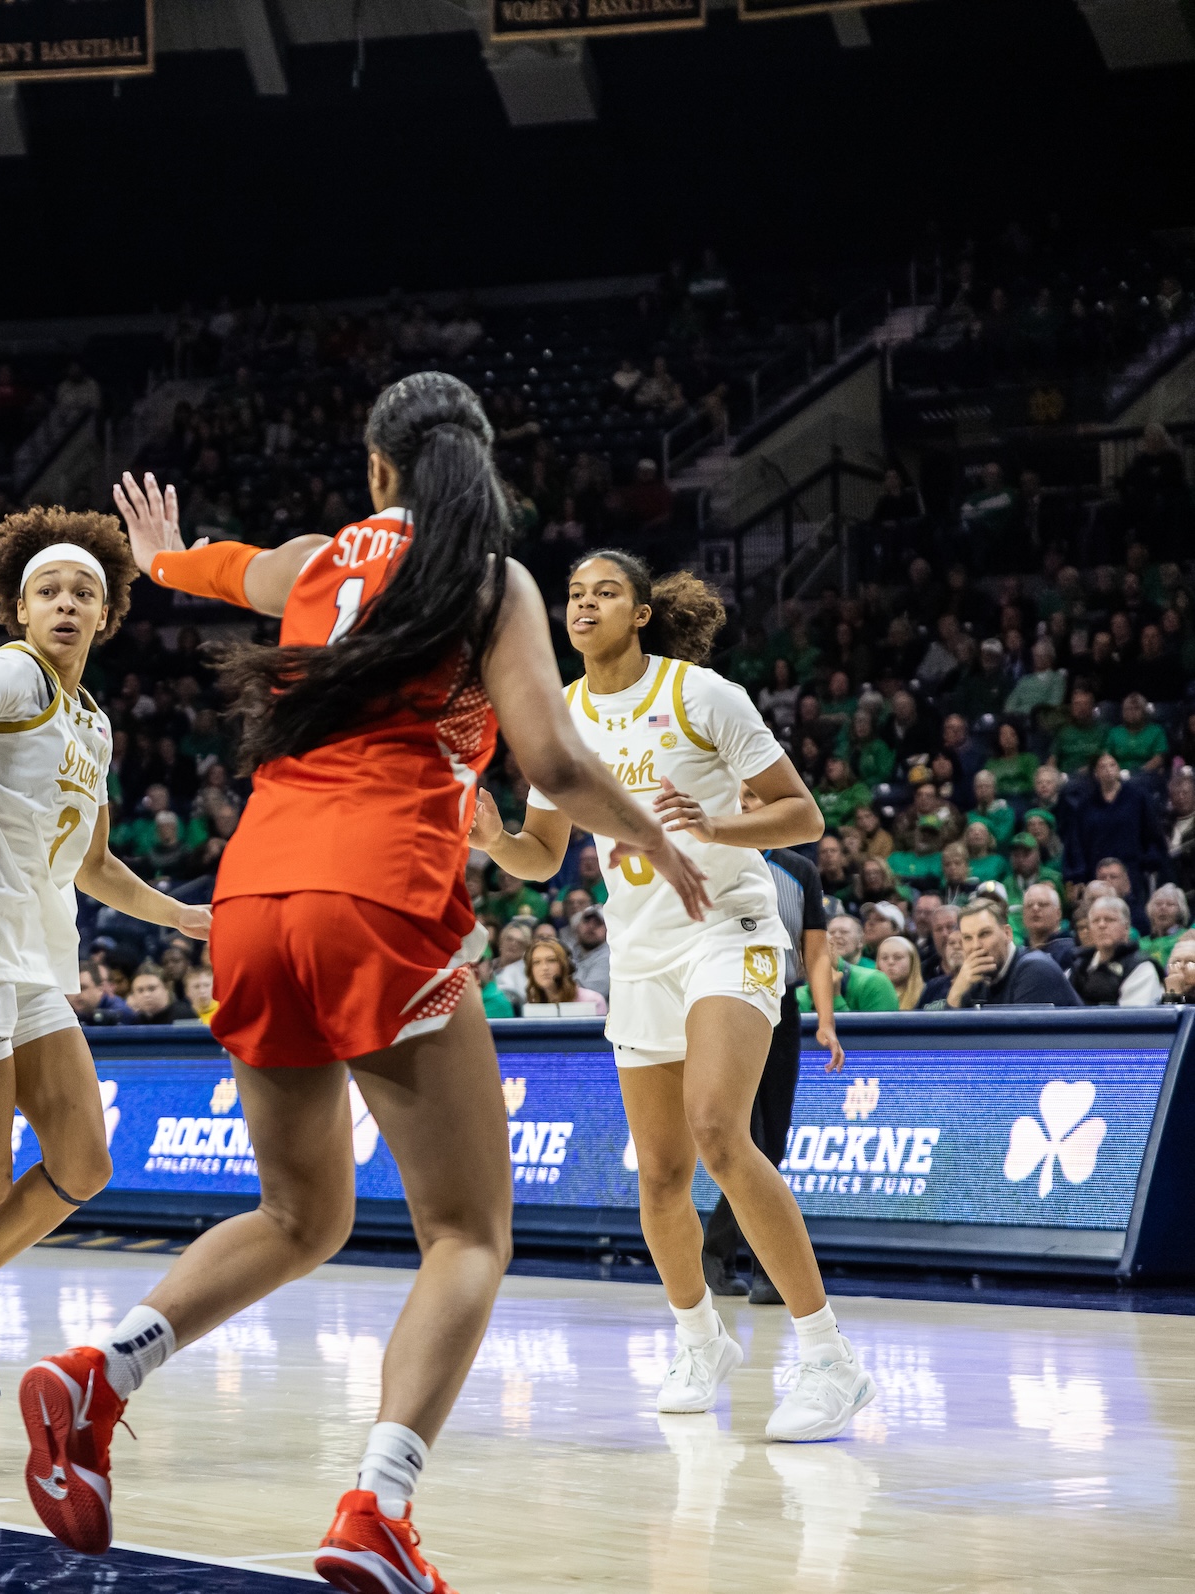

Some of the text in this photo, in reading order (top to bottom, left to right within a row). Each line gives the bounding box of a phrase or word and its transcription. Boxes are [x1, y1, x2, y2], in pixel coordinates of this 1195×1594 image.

[39, 36, 142, 62] BASKETBALL
[324, 576, 365, 647] 1
[779, 1125, 941, 1174] OCKNE
[144, 1156, 221, 1175] ATHLETICS
[514, 1166, 561, 1185] FUND
[871, 1176, 927, 1195] FUND
